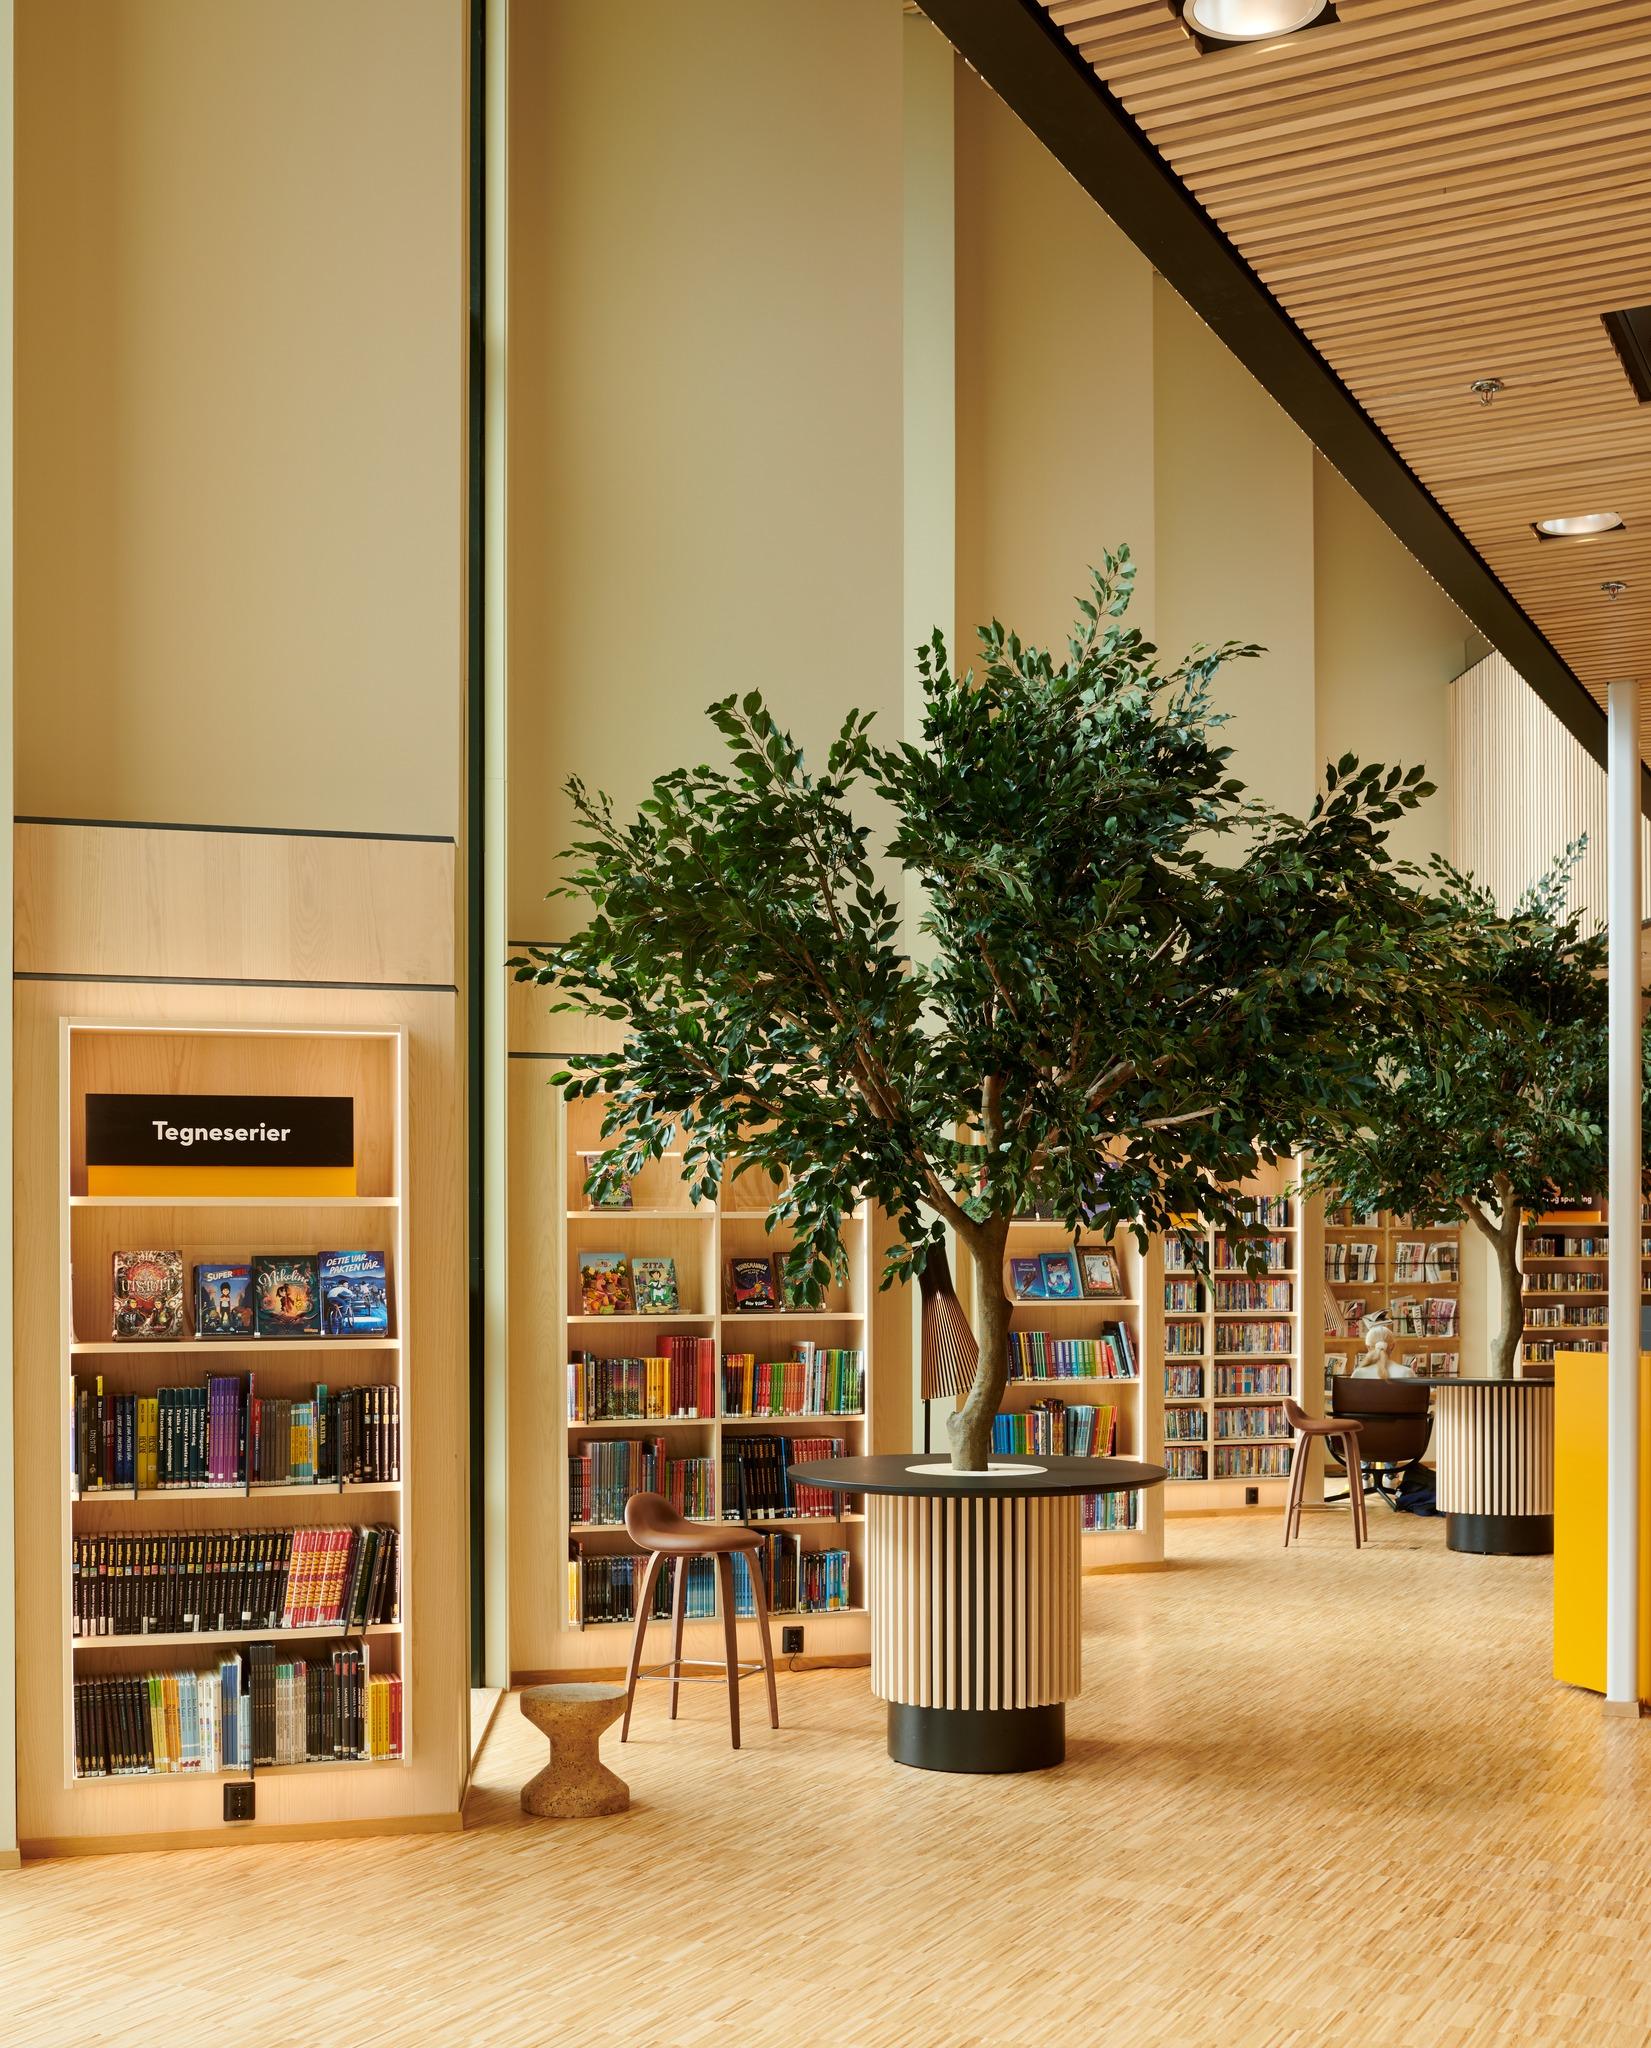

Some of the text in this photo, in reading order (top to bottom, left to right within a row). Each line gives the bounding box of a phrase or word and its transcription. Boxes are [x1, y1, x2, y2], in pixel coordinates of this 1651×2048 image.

[152, 1120, 291, 1146] Tegneserier
[326, 1254, 368, 1267] DETTE VAR
[329, 1260, 380, 1274] PAKTEN VÅR
[258, 1268, 309, 1286] Nikoline
